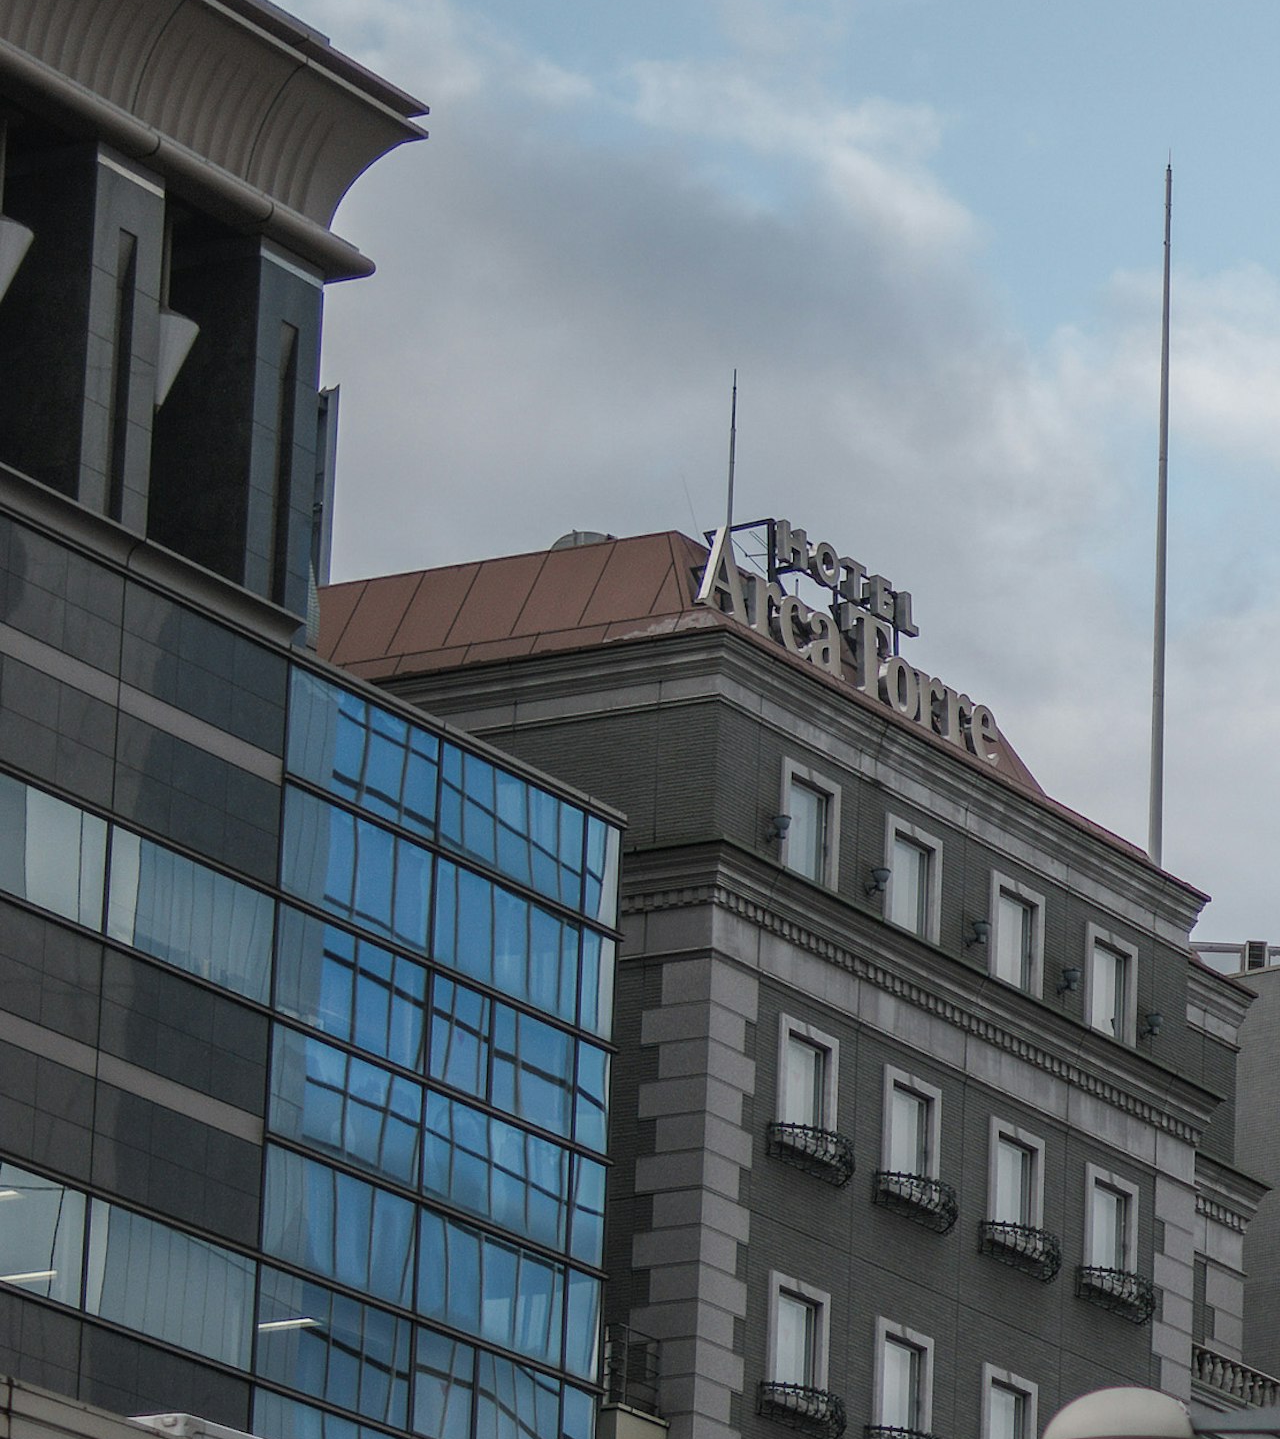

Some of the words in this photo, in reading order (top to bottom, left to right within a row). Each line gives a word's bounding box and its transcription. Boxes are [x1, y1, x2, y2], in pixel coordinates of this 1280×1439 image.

[695, 526, 845, 680] Arca
[840, 602, 1000, 766] Torre
[776, 519, 919, 637] HOTEL
